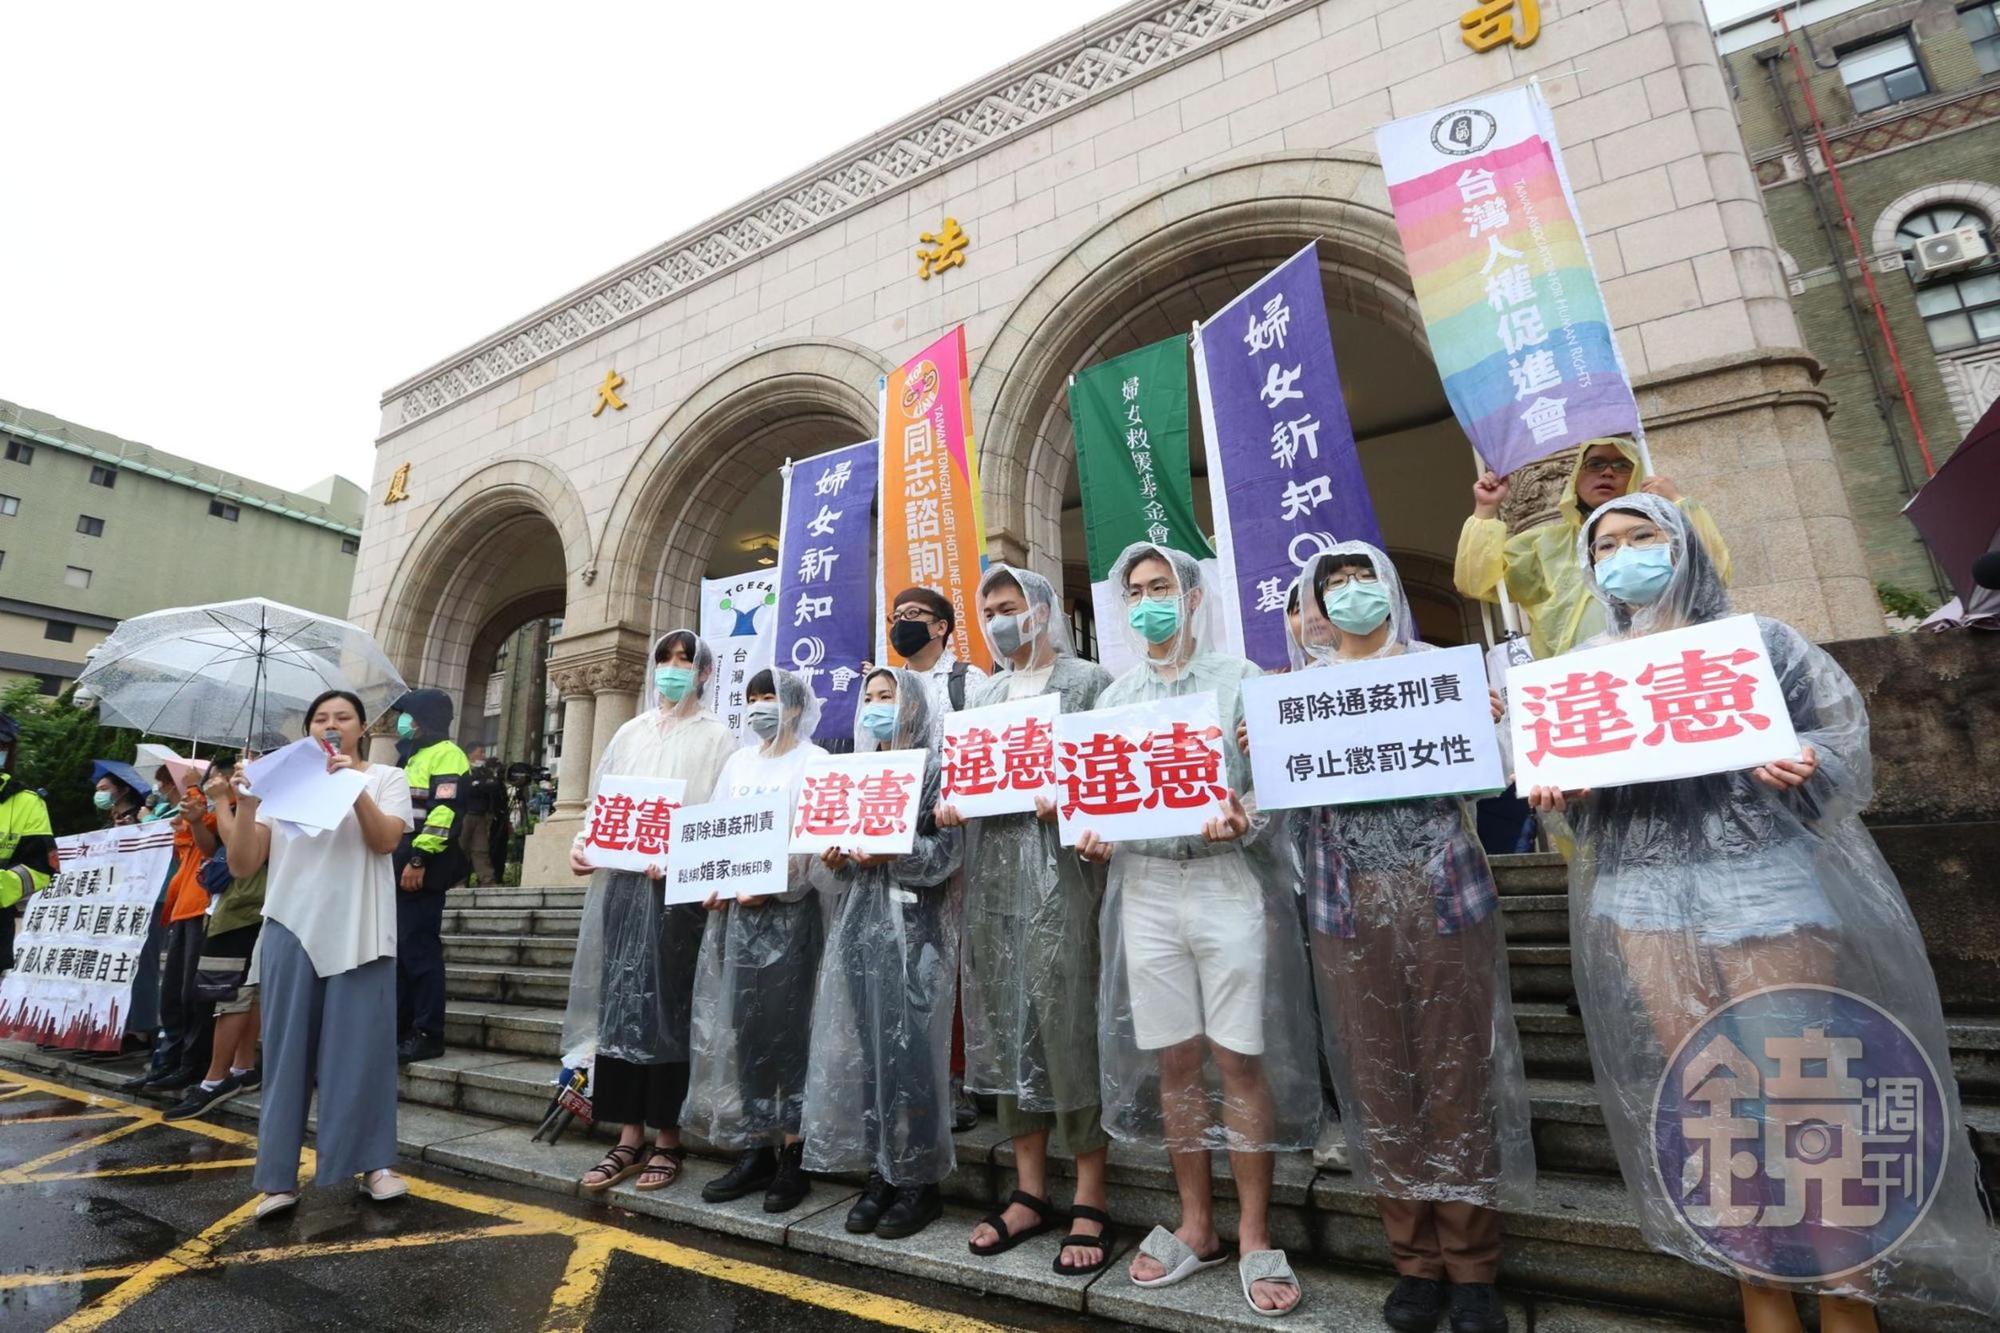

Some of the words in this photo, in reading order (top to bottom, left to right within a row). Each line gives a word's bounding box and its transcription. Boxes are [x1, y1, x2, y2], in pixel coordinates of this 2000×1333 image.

[916, 217, 970, 281] 法
[1455, 166, 1569, 445] 台灣人權促進會
[1512, 177, 1536, 215] TAIWAN
[1556, 299, 1577, 346] HUMAN
[1570, 345, 1592, 388] RIGHTS
[592, 368, 628, 418] 大
[1242, 291, 1333, 522] 婦女新知
[934, 404, 948, 449] TAIWAN
[937, 449, 952, 499] TONGZHI
[1121, 375, 1170, 546] 婦女救援基金會
[904, 418, 945, 597] 同志諮詢
[942, 502, 955, 532] LGBT
[793, 459, 852, 627] 婦女新知
[945, 534, 961, 586] HOTLINE
[725, 581, 774, 598] TGEEA
[951, 587, 971, 663] ASSOCIATION
[1278, 672, 1462, 726] 廢除通姦刑責
[1520, 647, 1772, 768] 違憲
[940, 716, 1056, 801] 違憲
[1057, 722, 1228, 822] 違憲
[1285, 733, 1475, 784] 停止懲罰女性
[584, 793, 682, 857] 違憲
[681, 810, 775, 844] 廢除通姦刑責
[795, 768, 917, 839] 違憲
[677, 859, 773, 884] 鬆綁婚家刻板印象
